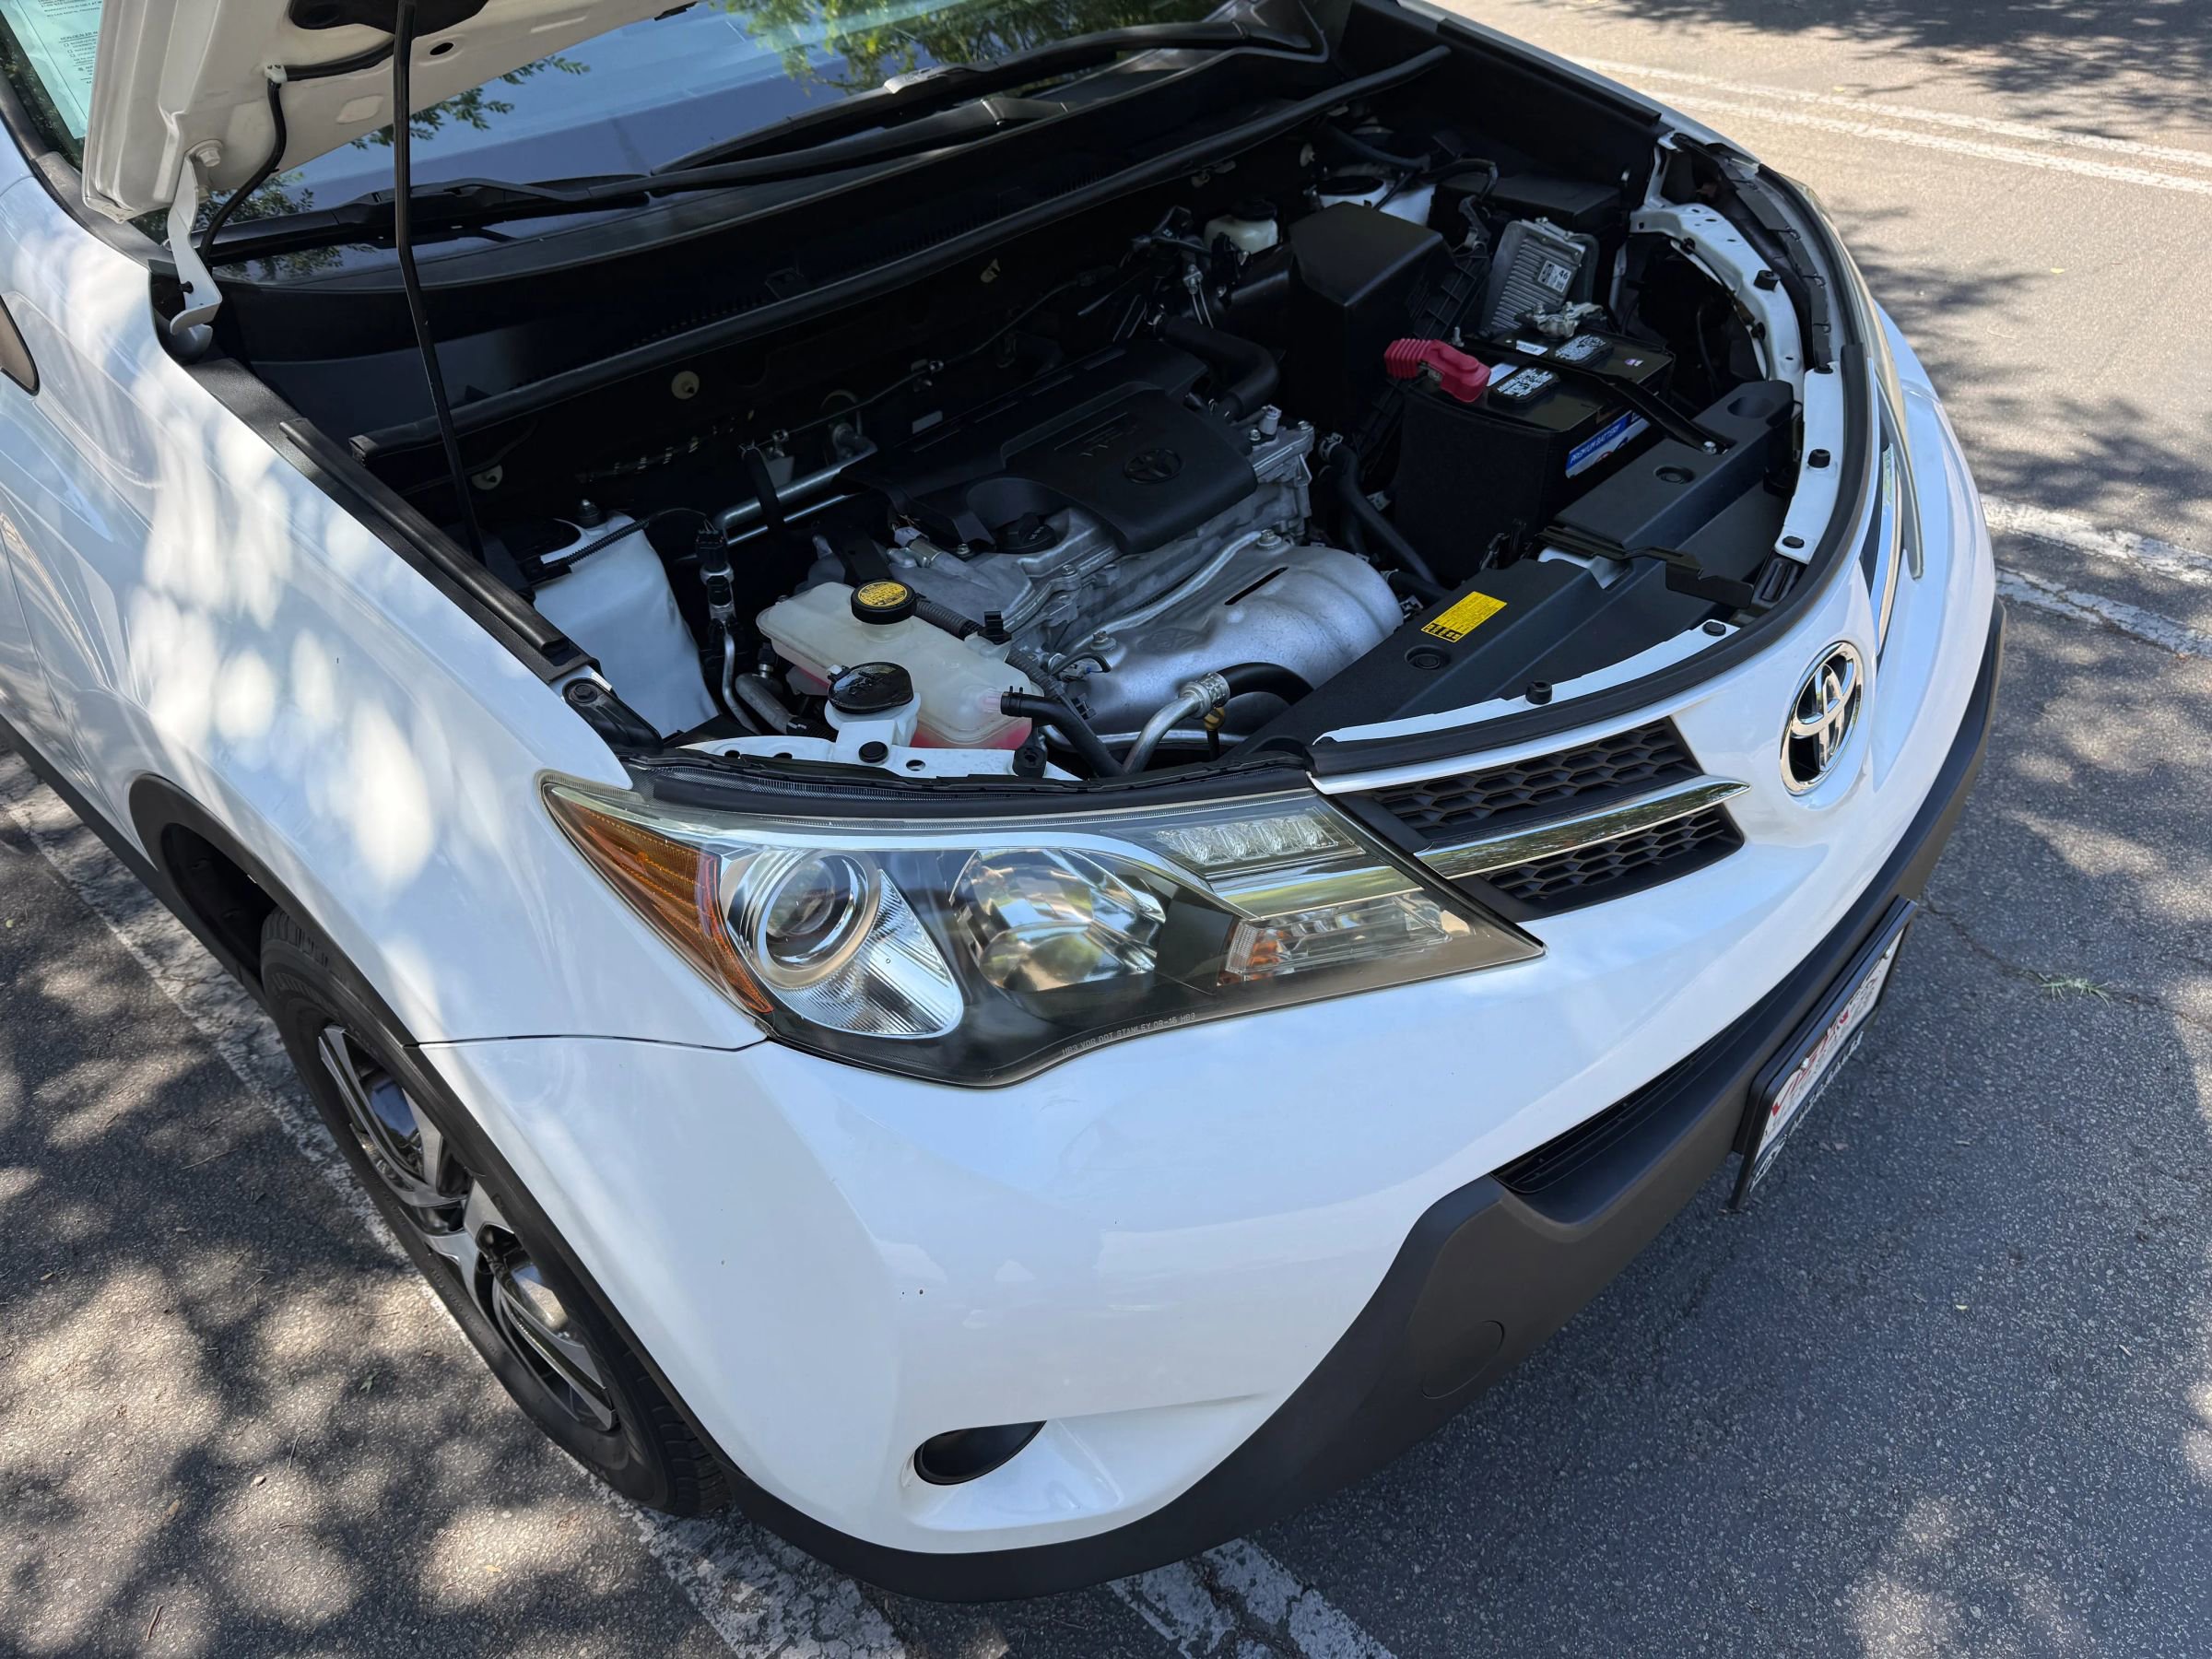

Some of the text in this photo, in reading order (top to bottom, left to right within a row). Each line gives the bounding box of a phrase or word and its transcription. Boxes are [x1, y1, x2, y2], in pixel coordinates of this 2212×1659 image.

[1559, 269, 1569, 280] 46
[1098, 1031, 1114, 1043] DOT
[1116, 1022, 1152, 1038] STANLEY
